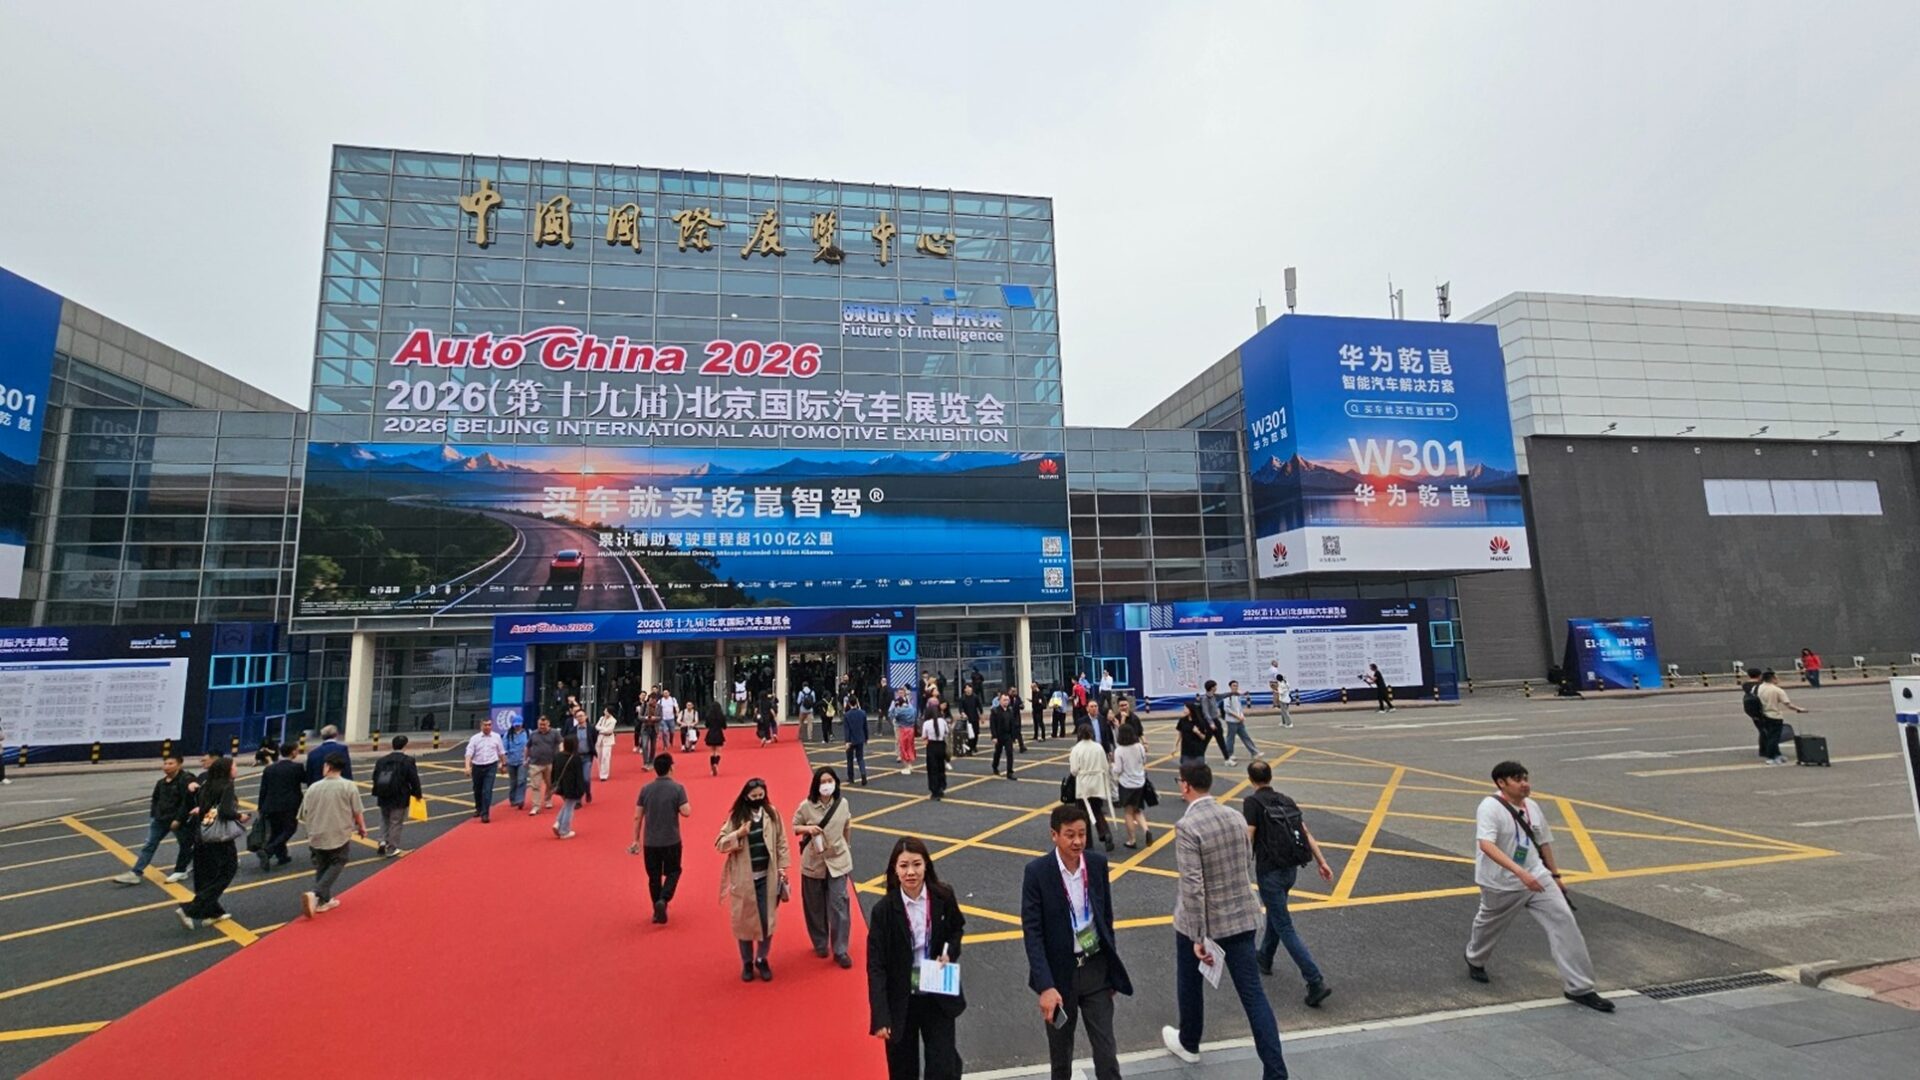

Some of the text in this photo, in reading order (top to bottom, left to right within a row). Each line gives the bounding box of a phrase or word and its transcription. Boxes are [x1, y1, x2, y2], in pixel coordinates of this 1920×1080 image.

[842, 323, 1004, 344] Future of Intelligence
[391, 327, 823, 379] Auto China 2026
[1339, 344, 1452, 375] 华为乾崑
[1342, 374, 1455, 394] 智能汽车解决方案
[385, 378, 1006, 426] 2026(第十九届)北京国际汽车展览会
[384, 416, 1009, 443] 2026 BEIJING INTERNATIONAL AUTOMOTIVE EXHIBITION
[1251, 406, 1286, 438] W301
[1348, 438, 1466, 477] W301
[1354, 483, 1471, 507] 华为乾崑
[599, 532, 834, 547] 累计辅助驾驶里程超100亿公里
[510, 622, 594, 634] Auto China 2026
[0, 637, 69, 648] 际汽车展览会
